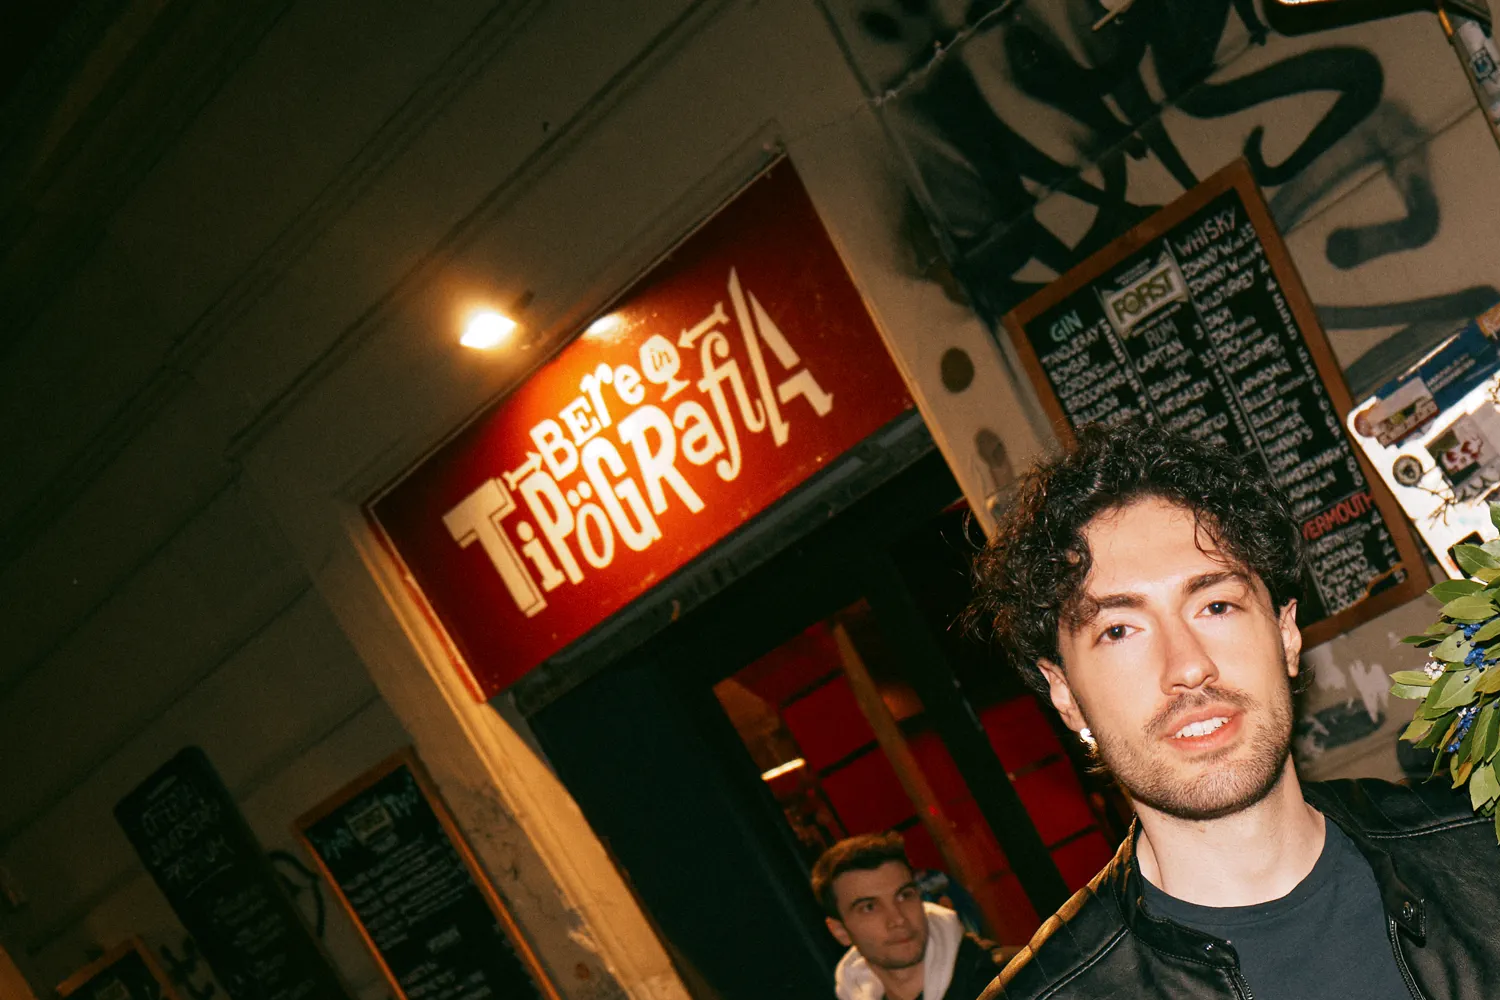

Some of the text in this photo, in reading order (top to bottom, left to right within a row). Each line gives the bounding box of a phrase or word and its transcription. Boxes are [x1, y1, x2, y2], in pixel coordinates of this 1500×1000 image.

[1176, 208, 1235, 256] WHISKY
[1260, 260, 1270, 273] 4
[1267, 278, 1276, 291] 4
[1112, 269, 1175, 322] FORST
[1273, 293, 1284, 310] 5
[1280, 308, 1290, 324] 5
[1050, 310, 1083, 341] GIN
[1099, 318, 1111, 335] 5
[1144, 319, 1178, 348] RUM
[1193, 324, 1204, 340] 3
[1287, 324, 1297, 340] 5
[1050, 334, 1118, 384] BOMBAY 5
[1114, 348, 1125, 364] 5
[1297, 346, 1308, 363] 5
[1125, 365, 1133, 380] 6
[1214, 368, 1224, 385] 5
[1304, 364, 1315, 380] 5
[1148, 370, 1191, 400] BRUGAL
[1313, 380, 1322, 395] 6
[1222, 387, 1233, 404] 5
[1229, 404, 1240, 420] 5
[1319, 398, 1329, 411] 6
[1236, 420, 1247, 433] 5
[1325, 411, 1335, 427] 6
[1347, 456, 1357, 472] 8
[1353, 471, 1363, 486] 8
[1302, 490, 1374, 541] VERMOUTH
[1371, 511, 1382, 524] 4
[1310, 541, 1364, 578] CARPANO
[1379, 529, 1389, 540] 4
[1383, 543, 1395, 556] 4
